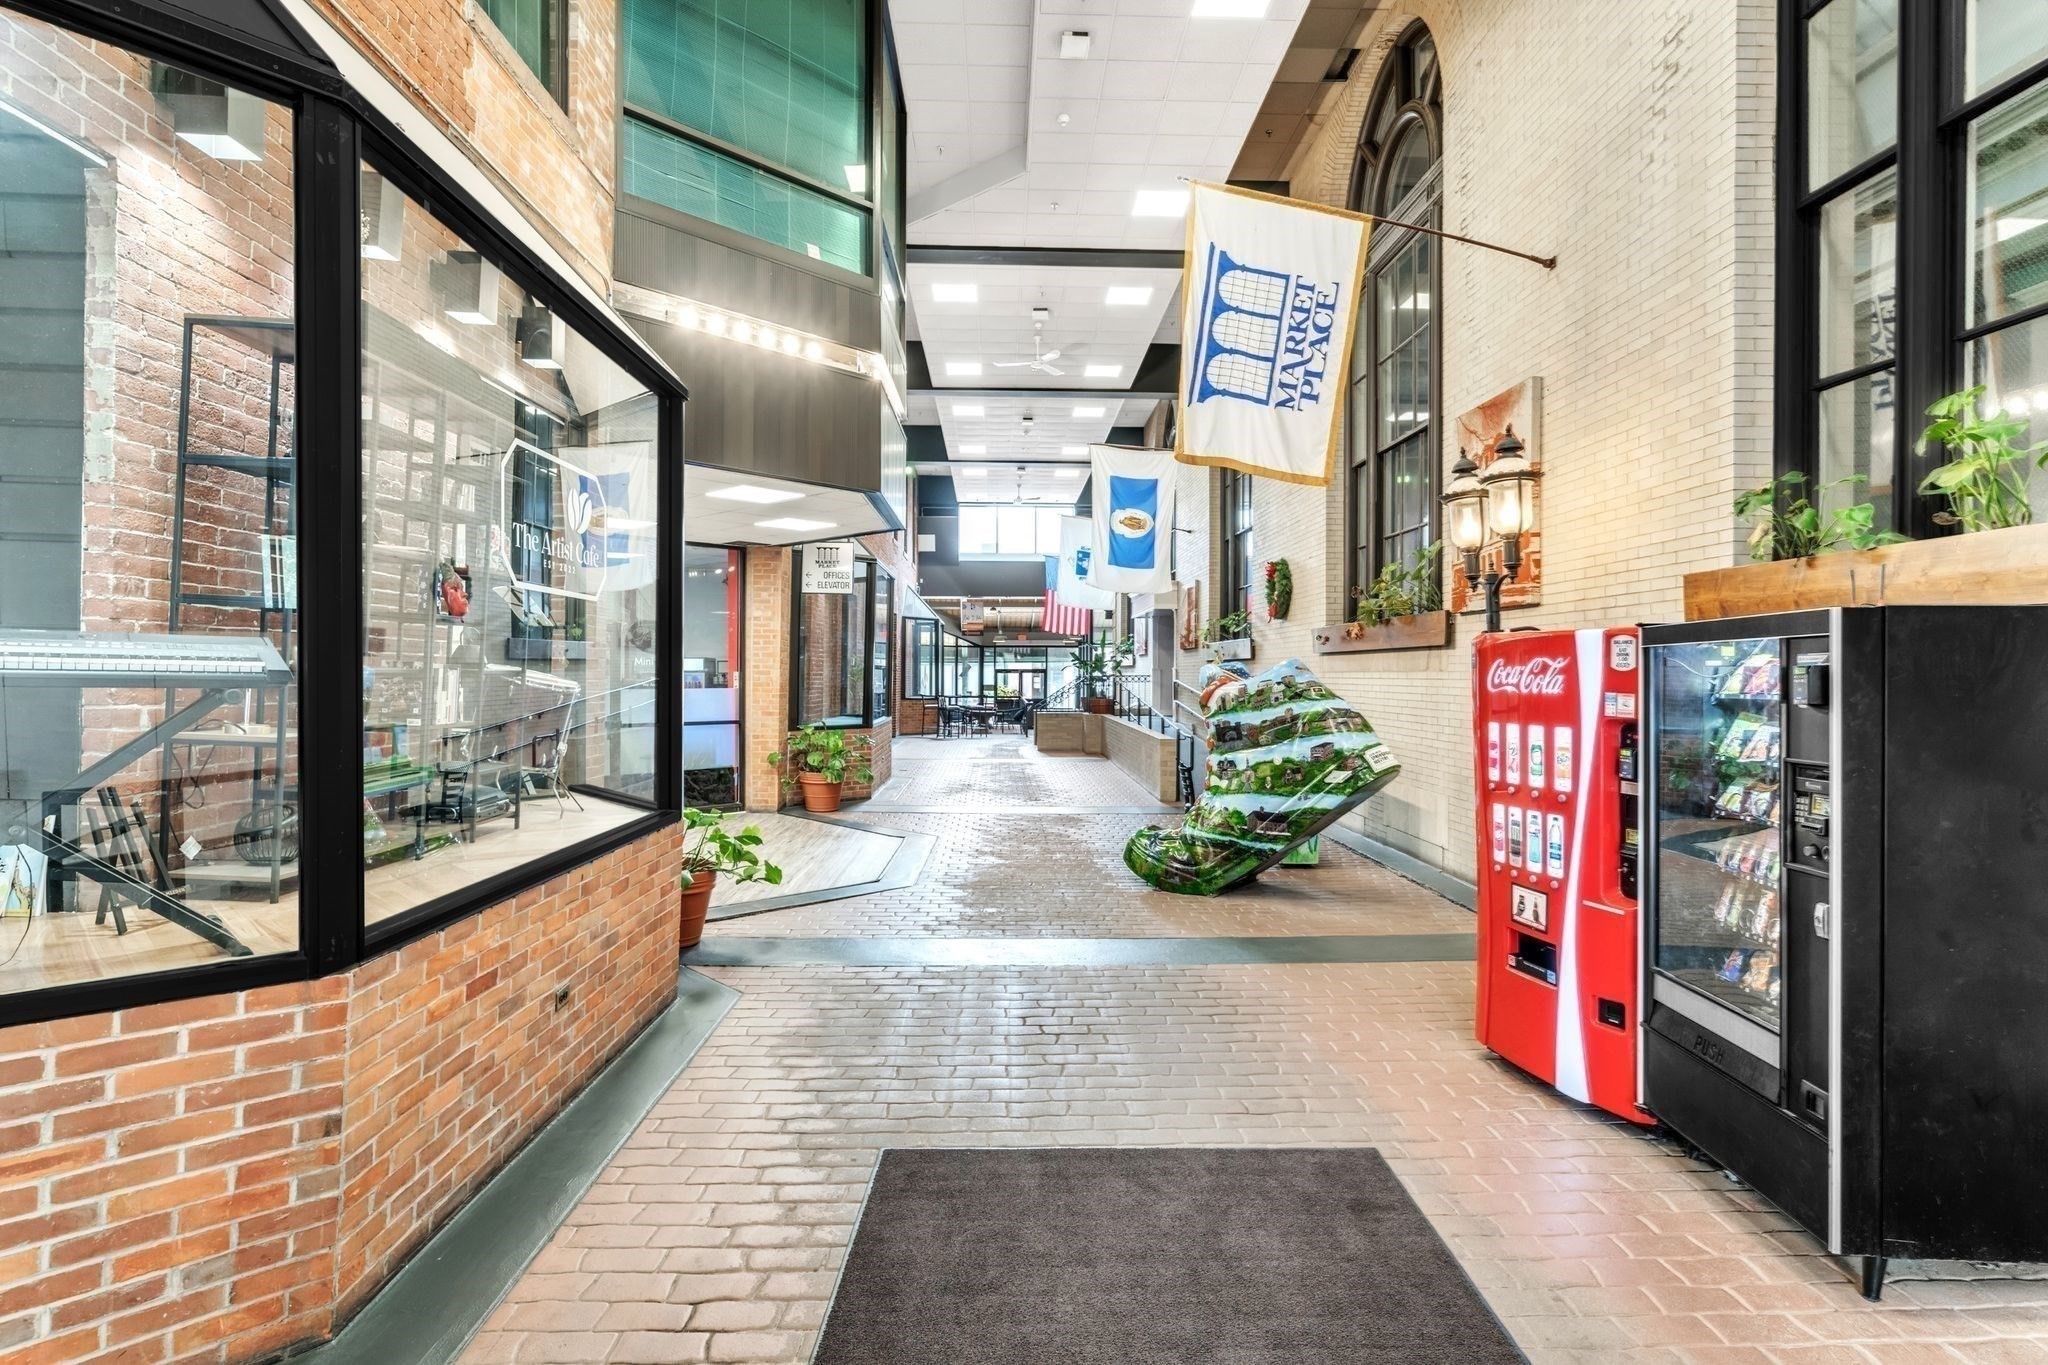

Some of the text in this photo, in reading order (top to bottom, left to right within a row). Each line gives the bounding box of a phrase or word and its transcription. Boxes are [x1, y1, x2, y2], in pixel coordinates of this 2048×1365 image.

[1274, 275, 1315, 411] MARKET
[1298, 282, 1339, 411] PLACE
[512, 522, 539, 552] The
[541, 531, 574, 562] Artist
[544, 559, 577, 575] EST 2022
[823, 571, 850, 579] OFFICES
[817, 581, 850, 589] ELEVATOR
[1487, 656, 1570, 695] Coca-Cola
[1693, 1035, 1724, 1064] PUSH
